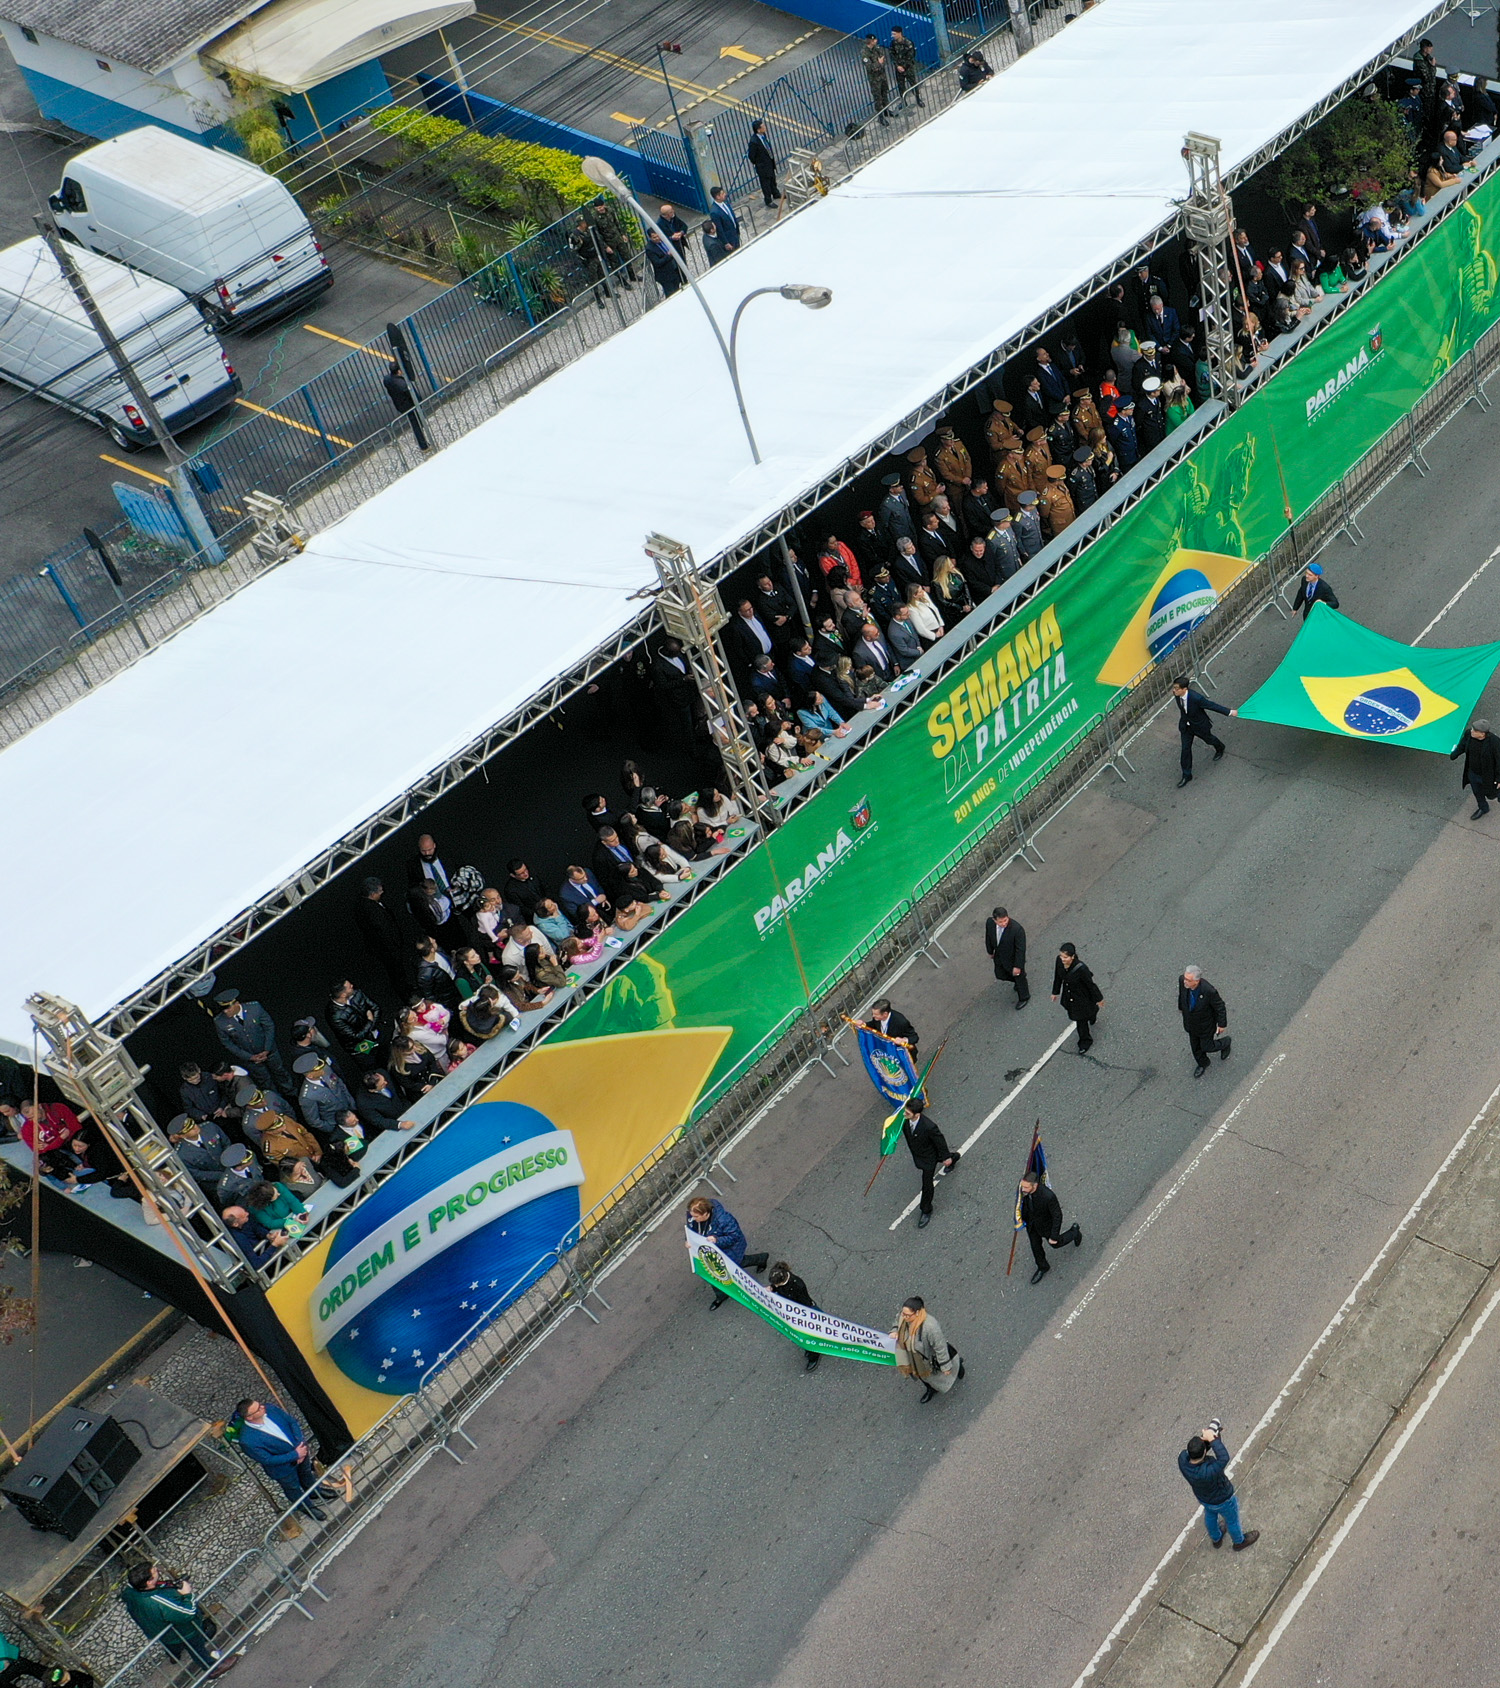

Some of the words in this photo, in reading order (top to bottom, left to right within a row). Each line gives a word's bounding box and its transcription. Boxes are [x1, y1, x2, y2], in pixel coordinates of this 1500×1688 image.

[1306, 345, 1369, 417] PARANÁ
[1146, 614, 1168, 638] ORDEM
[1169, 608, 1175, 620] E
[927, 602, 1064, 759] SEMANA
[943, 743, 972, 795] DA
[975, 651, 1067, 765] PÁTRIA
[954, 800, 973, 825] 201
[972, 777, 997, 808] ANOS
[997, 761, 1010, 784] DE
[1008, 697, 1079, 771] INDEPENDÊNCIA
[753, 826, 853, 932] PARANÁ
[760, 891, 814, 942] GOVERNO
[820, 870, 833, 885] DO
[840, 825, 879, 866] ESTADO
[318, 1239, 395, 1322] ORDEM
[403, 1220, 422, 1252] E
[428, 1146, 568, 1234] PROGRESSO
[734, 1268, 783, 1309] ASSOCIAÇÃO
[785, 1303, 807, 1318] DOS
[810, 1312, 880, 1340] DIPLOMADOS
[774, 1308, 822, 1333] SUPERIOR
[825, 1327, 839, 1338] DE
[841, 1332, 885, 1349] GUERRA
